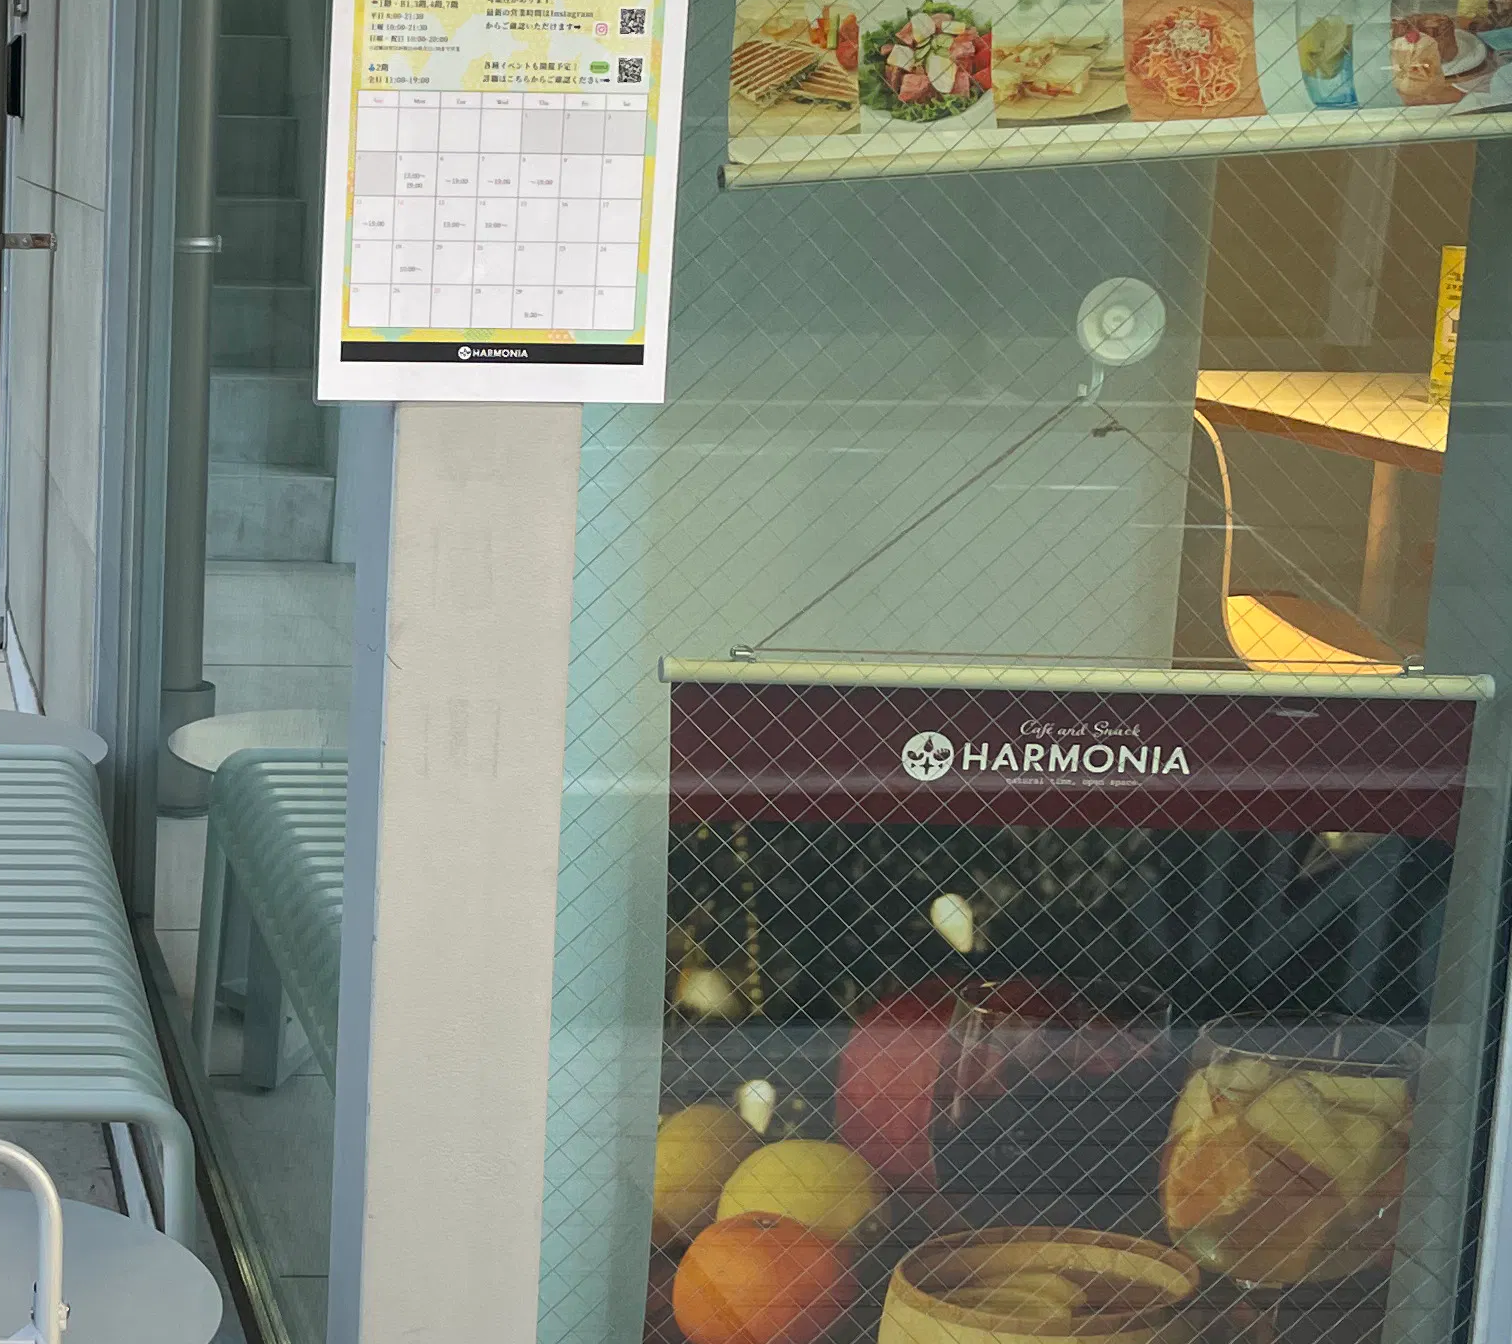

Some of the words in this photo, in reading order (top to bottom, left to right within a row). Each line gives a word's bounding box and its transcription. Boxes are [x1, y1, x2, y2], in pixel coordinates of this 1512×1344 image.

[472, 348, 529, 358] HARMONIA
[1057, 723, 1086, 737] and
[962, 742, 1191, 775] HARMONIA
